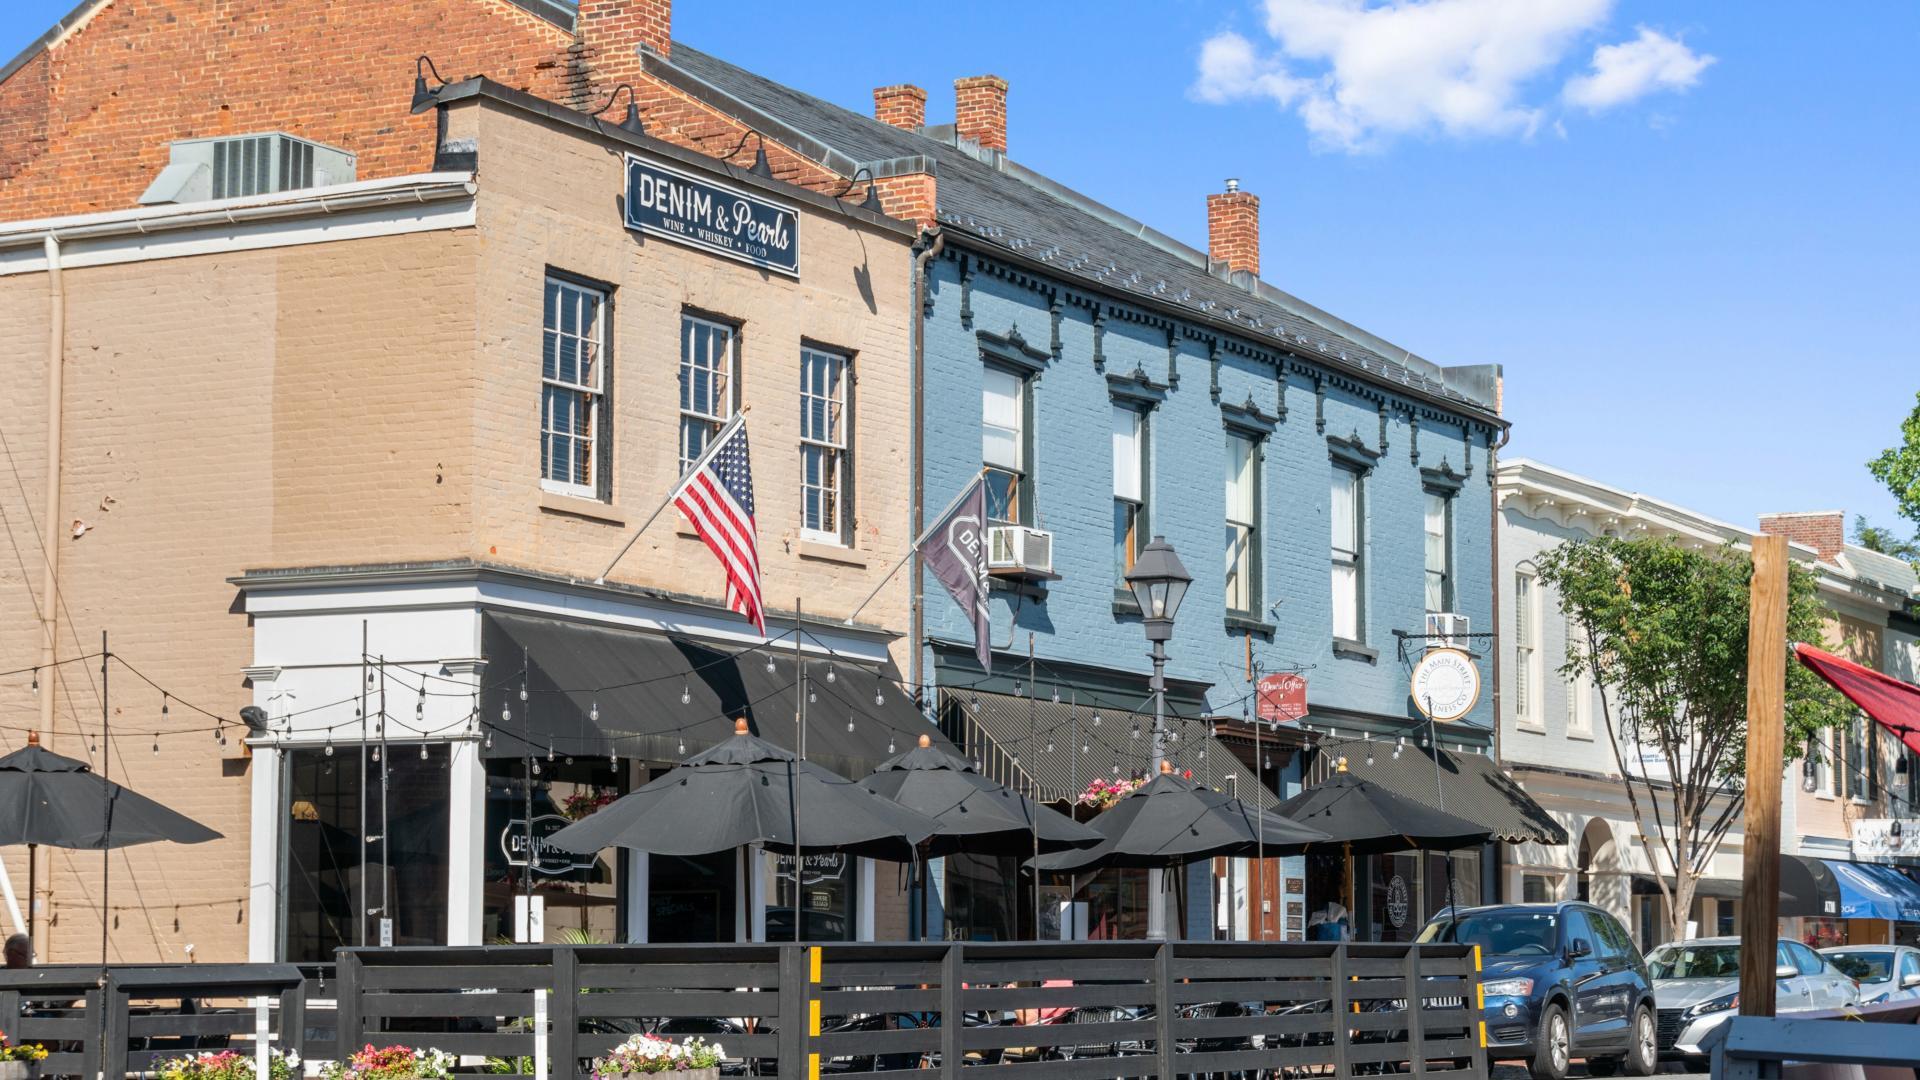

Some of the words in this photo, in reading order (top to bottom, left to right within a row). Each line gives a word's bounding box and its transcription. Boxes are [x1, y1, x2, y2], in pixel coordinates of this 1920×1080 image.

[639, 173, 712, 227] DENIM
[715, 205, 729, 232] &
[732, 200, 790, 251] Pearls
[663, 217, 686, 234] WINE
[697, 229, 734, 248] WHISKEY
[745, 244, 767, 258] FOOD
[1429, 657, 1451, 670] MAIN
[1260, 678, 1286, 692] Dental
[1284, 678, 1303, 694] Office
[1824, 900, 1837, 913] ATM
